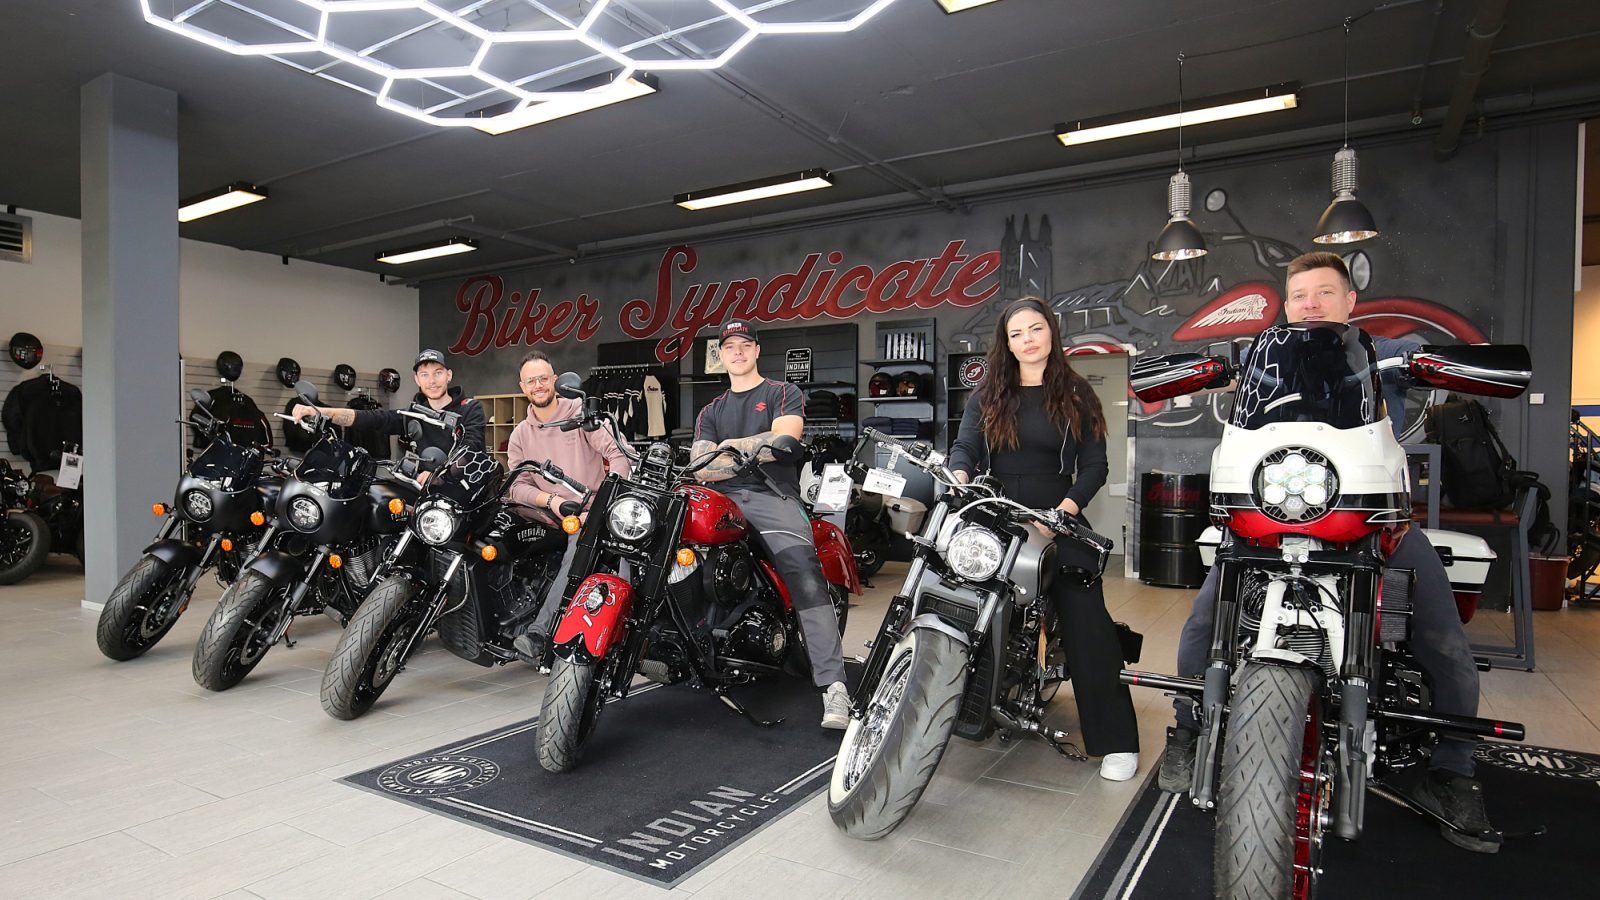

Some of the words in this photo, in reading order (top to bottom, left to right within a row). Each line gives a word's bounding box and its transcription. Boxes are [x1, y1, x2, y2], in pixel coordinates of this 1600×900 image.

[448, 275, 602, 357] Biker
[619, 240, 1001, 363] Syndicate
[1217, 308, 1247, 316] Indian
[786, 363, 809, 371] INDIAN
[397, 756, 450, 770] INDIAN
[382, 776, 436, 794] COMPANY
[600, 785, 756, 862] INDIAN
[649, 794, 779, 870] MOTORCYCLE
